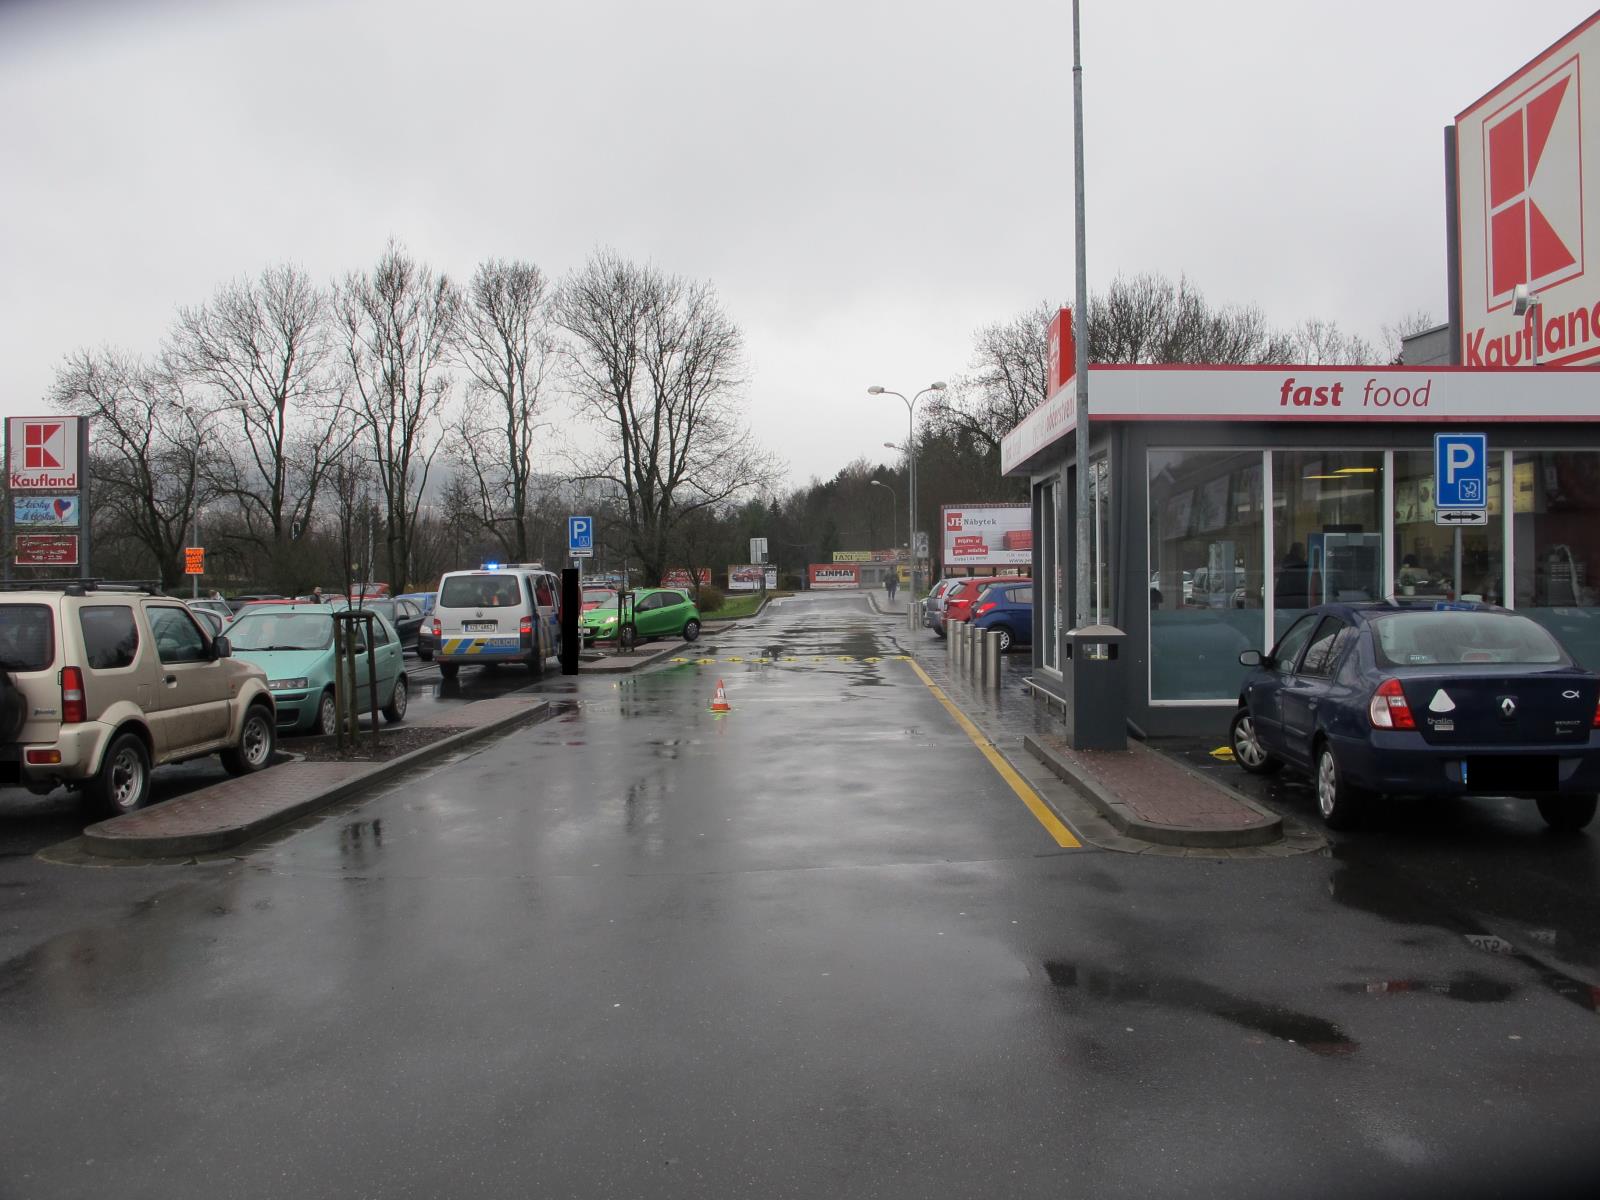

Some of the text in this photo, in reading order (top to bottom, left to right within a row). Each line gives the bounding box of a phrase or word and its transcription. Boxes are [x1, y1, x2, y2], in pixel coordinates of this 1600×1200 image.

[1280, 378, 1432, 408] fast food
[1447, 443, 1475, 484] P
[11, 473, 76, 487] Kaufland
[573, 520, 587, 539] P
[963, 517, 997, 526] Nábytek
